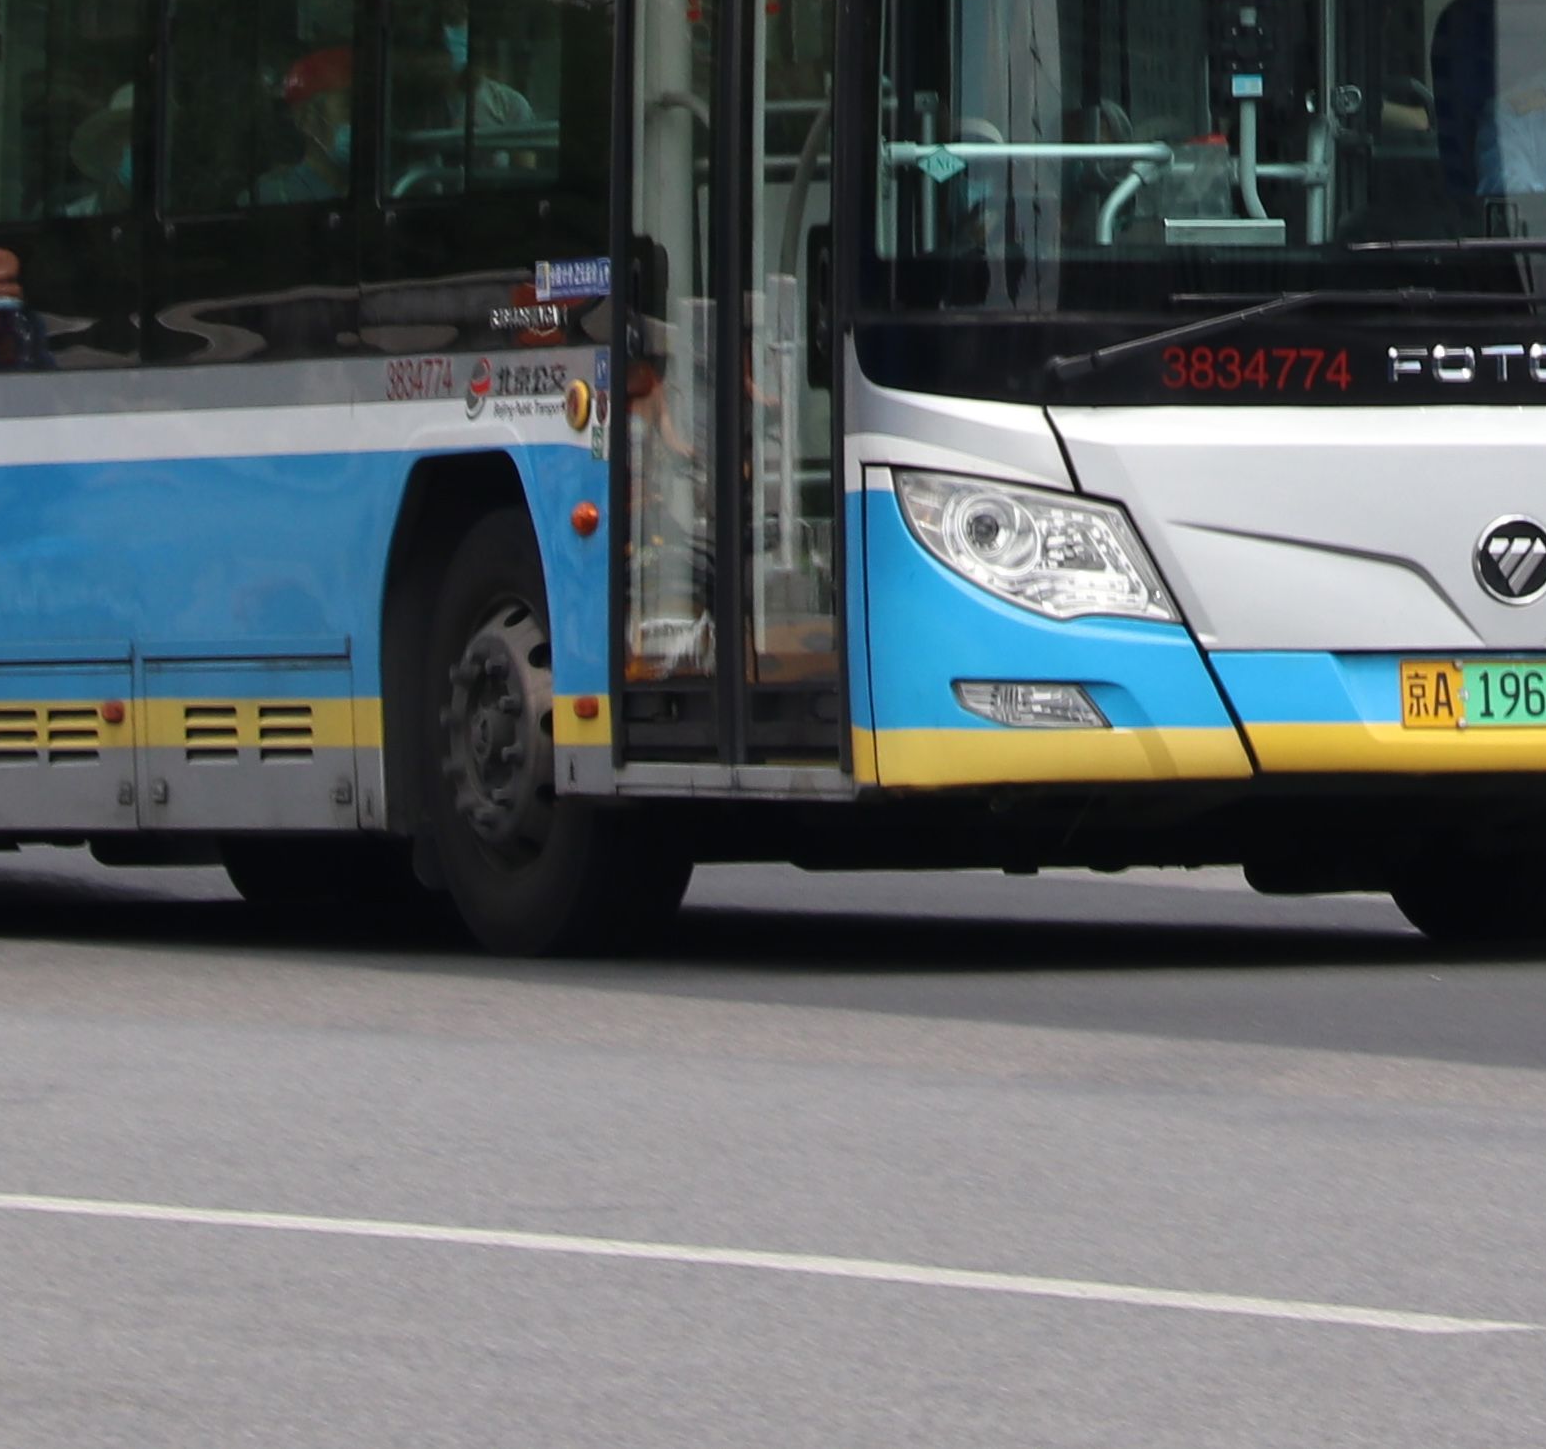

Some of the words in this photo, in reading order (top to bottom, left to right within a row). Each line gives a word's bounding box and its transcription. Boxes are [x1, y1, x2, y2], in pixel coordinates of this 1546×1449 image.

[385, 357, 453, 401] 3834774
[496, 362, 568, 397] 北京公交
[1162, 346, 1352, 391] 3834774
